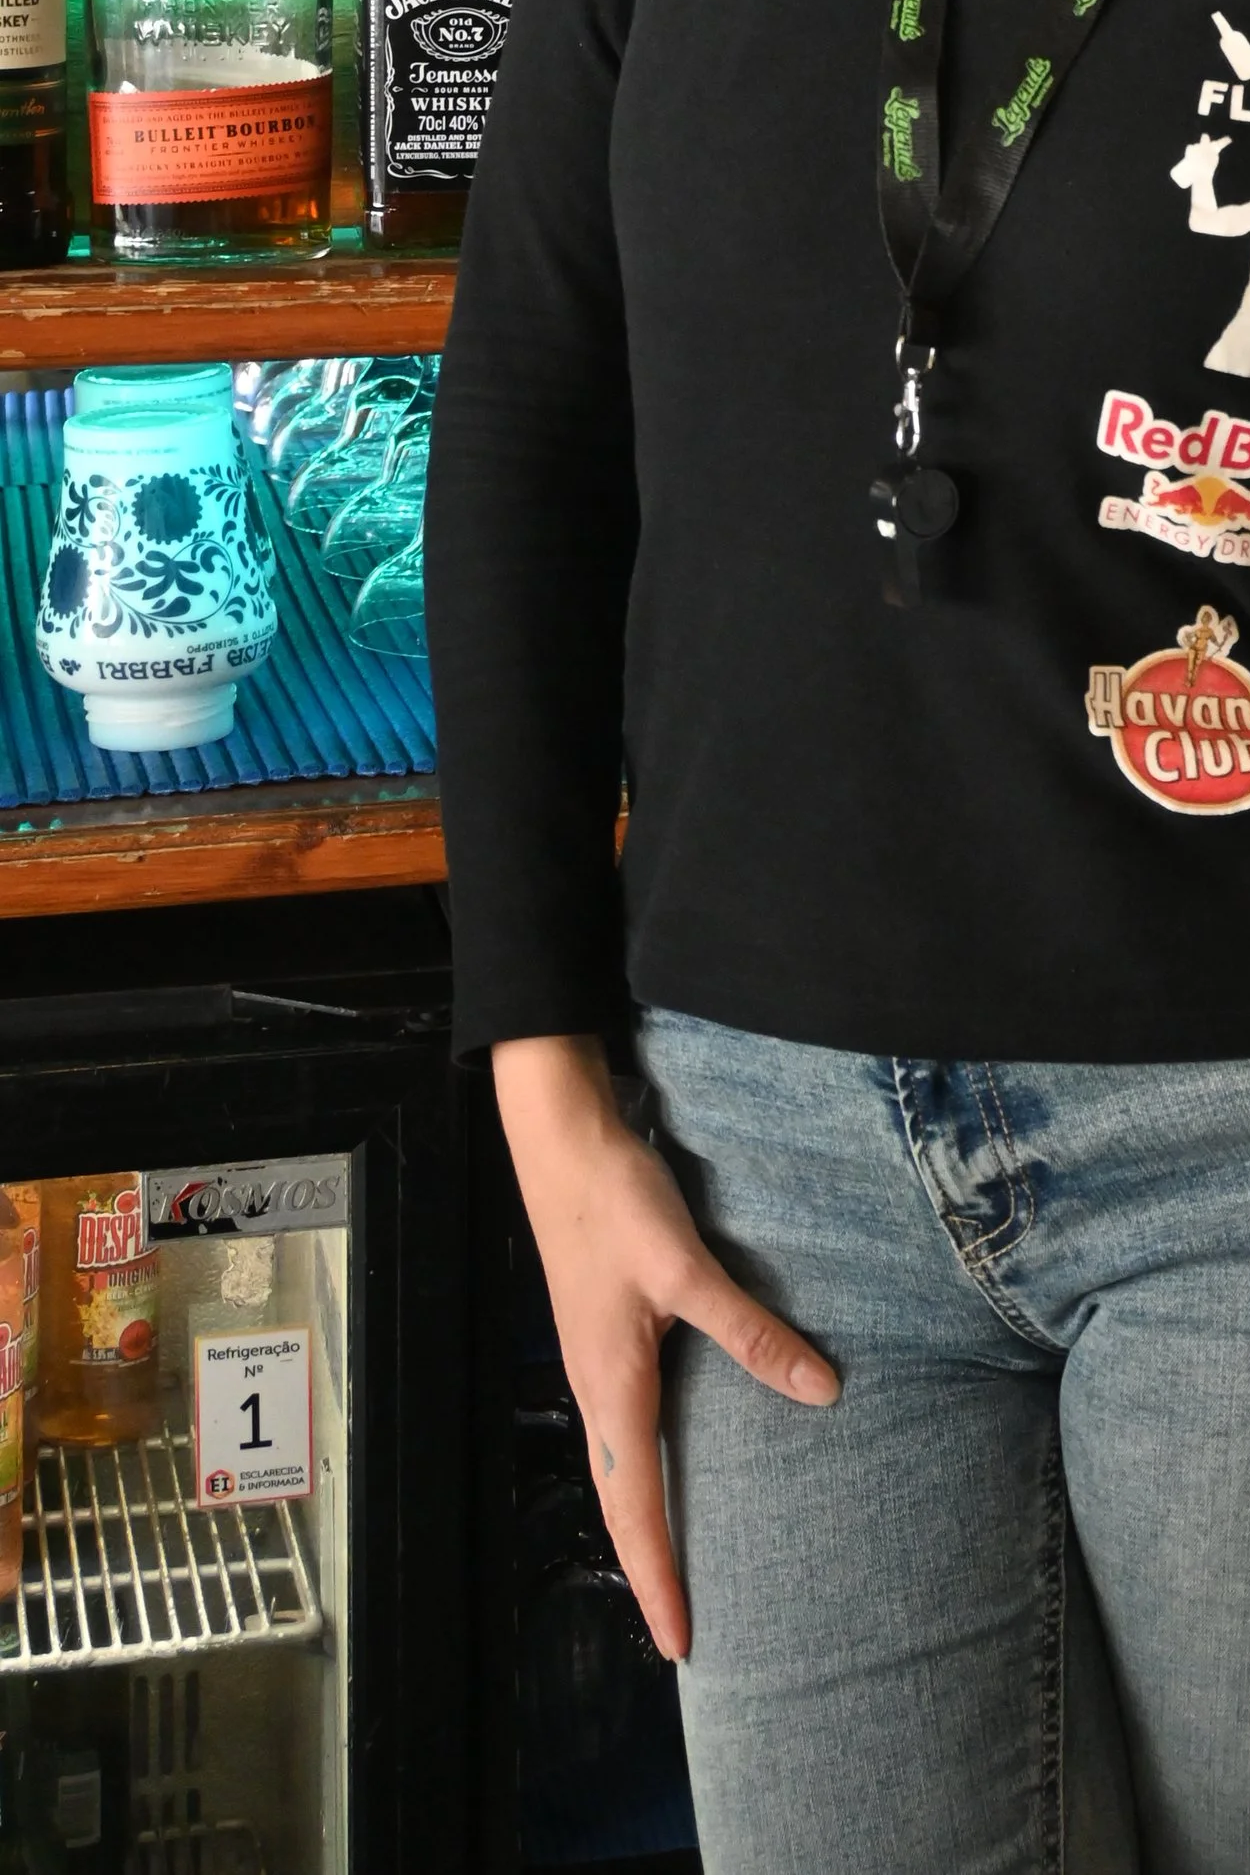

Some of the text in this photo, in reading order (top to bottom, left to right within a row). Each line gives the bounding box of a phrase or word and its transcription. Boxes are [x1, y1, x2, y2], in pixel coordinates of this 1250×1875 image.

[0, 14, 29, 28] KEY
[439, 27, 485, 43] No.7
[434, 86, 489, 94] SOUR MASH
[992, 57, 1052, 147] Legends
[167, 113, 192, 123] AGED
[208, 111, 224, 120] THE
[418, 114, 478, 131] 70cl 40%
[134, 114, 316, 144] BULLEIT BOURBON
[407, 133, 447, 142] DISTILLED
[448, 133, 465, 142] AND
[884, 86, 923, 182] Legends
[150, 134, 303, 156] FRONTIER WHISKEY
[394, 141, 421, 150] JACK
[423, 141, 463, 150] DANIEL
[175, 159, 232, 171] STRAIGHT
[238, 153, 290, 166] BOURBON
[441, 151, 479, 159] TENNESSE
[1103, 397, 1220, 466] Red
[1105, 503, 1210, 553] ENERGY
[186, 636, 238, 654] SCIROPPO
[96, 654, 215, 681] FABBRI
[157, 1176, 340, 1225] KOSMOS
[207, 1340, 301, 1362] Refrigeração
[244, 1364, 264, 1378] Nº
[239, 1392, 273, 1451] 1
[210, 1465, 304, 1493] EI ESCLARECIDA
[247, 1476, 306, 1491] INFORMADA
